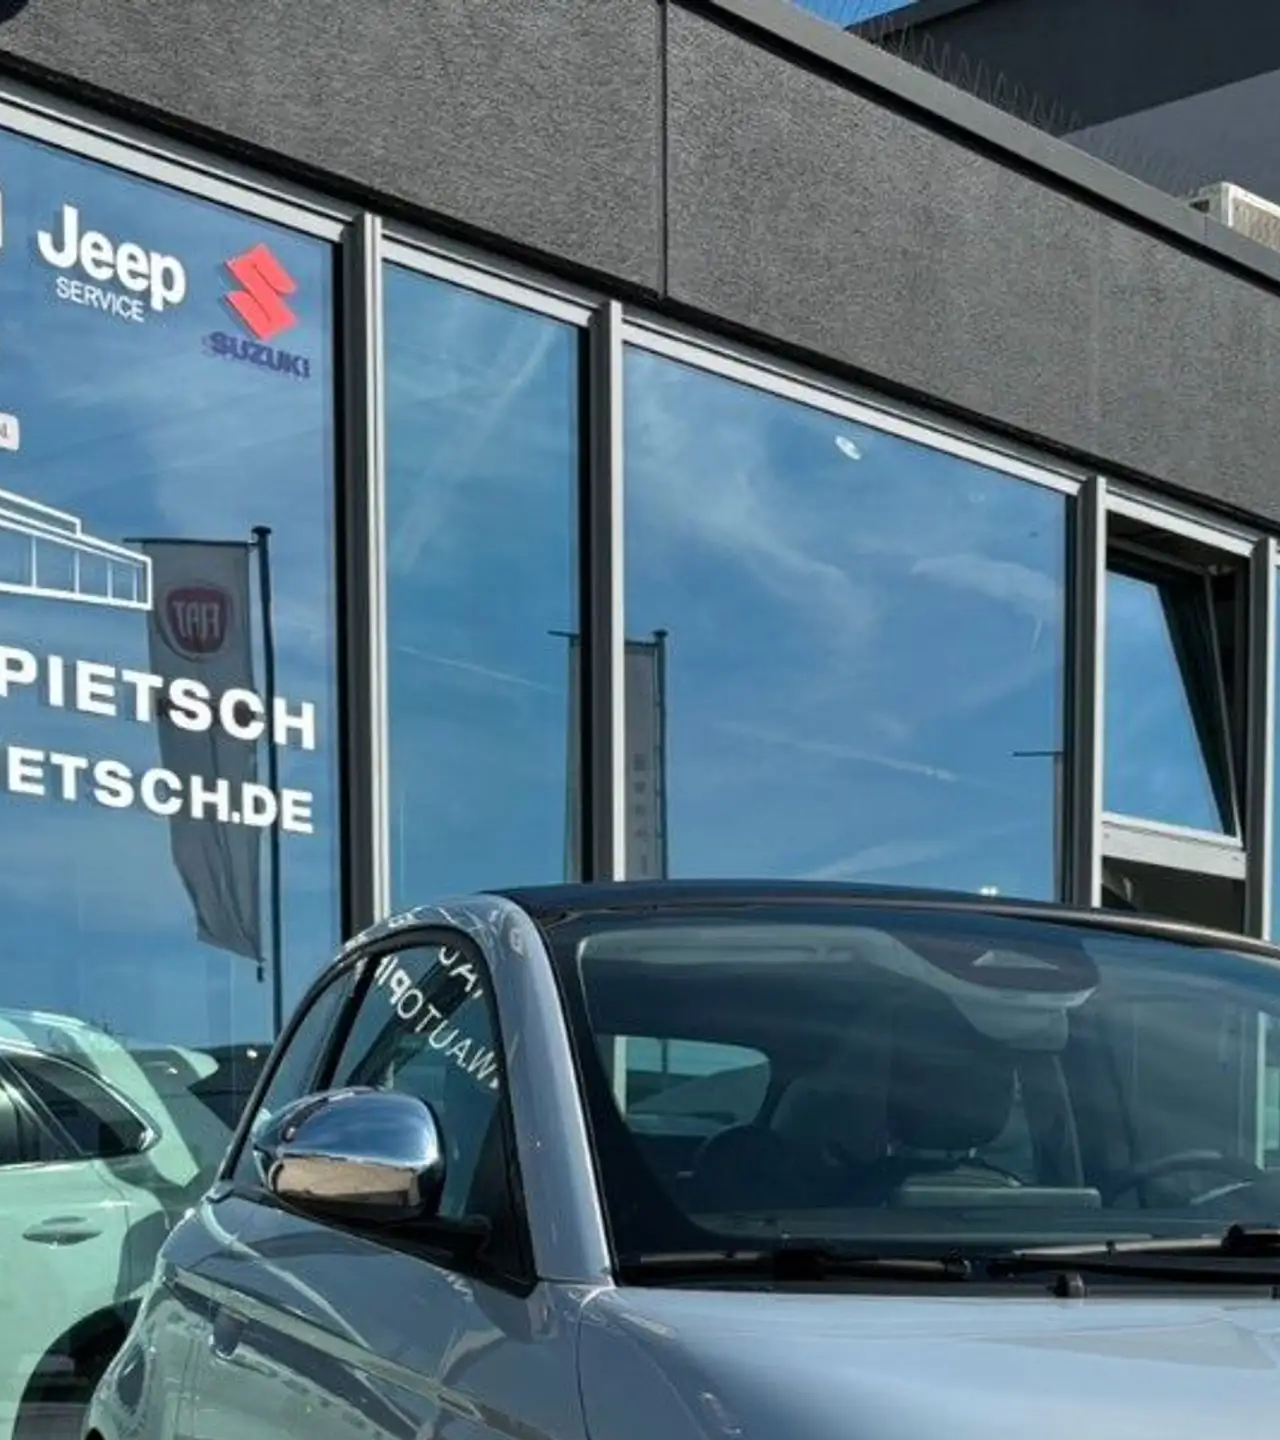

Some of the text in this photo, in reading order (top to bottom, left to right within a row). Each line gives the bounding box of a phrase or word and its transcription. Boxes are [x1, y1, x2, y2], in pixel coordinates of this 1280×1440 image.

[36, 204, 187, 311] Jeep
[54, 275, 145, 323] SERVICE
[209, 330, 311, 379] SUZUKI
